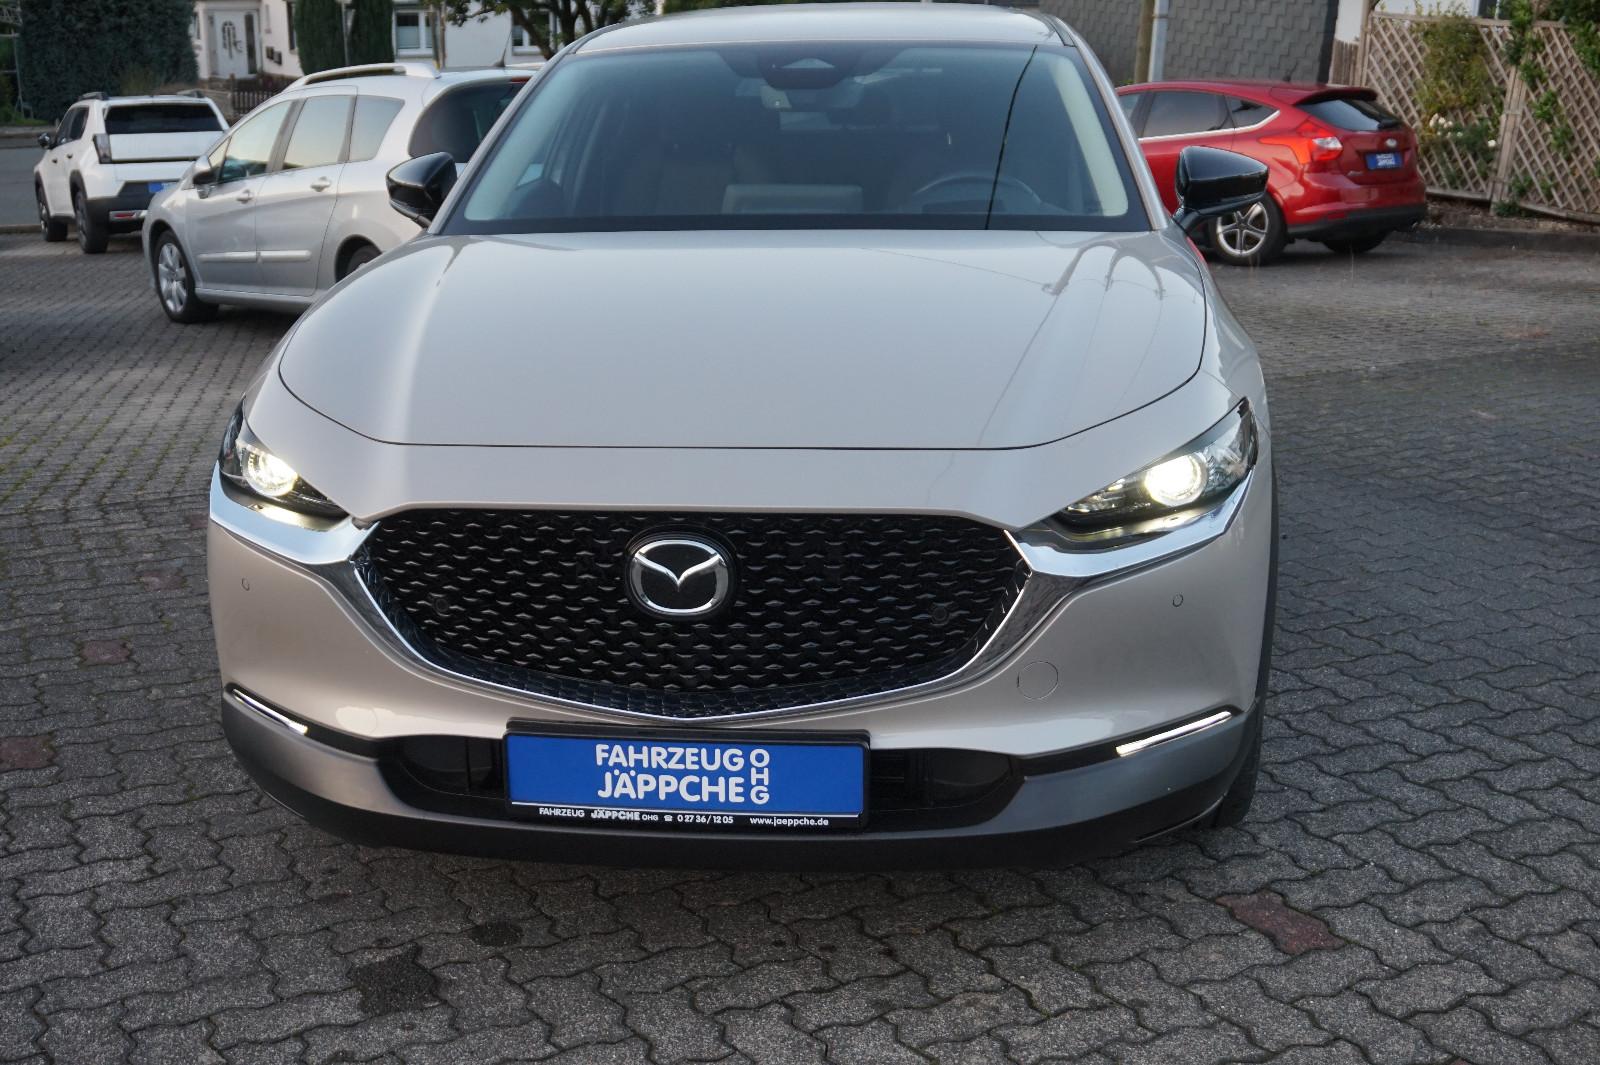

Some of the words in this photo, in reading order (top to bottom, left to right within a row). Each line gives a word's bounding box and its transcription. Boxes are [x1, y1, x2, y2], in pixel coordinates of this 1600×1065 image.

[595, 743, 745, 772] FAHRZEUG
[597, 768, 745, 803] JÄPPCHE
[538, 807, 585, 818] FAHRZEUG
[590, 808, 641, 821] JÄPPCHE
[641, 813, 659, 822] OHG
[749, 816, 829, 827] www.jaeppche.de
